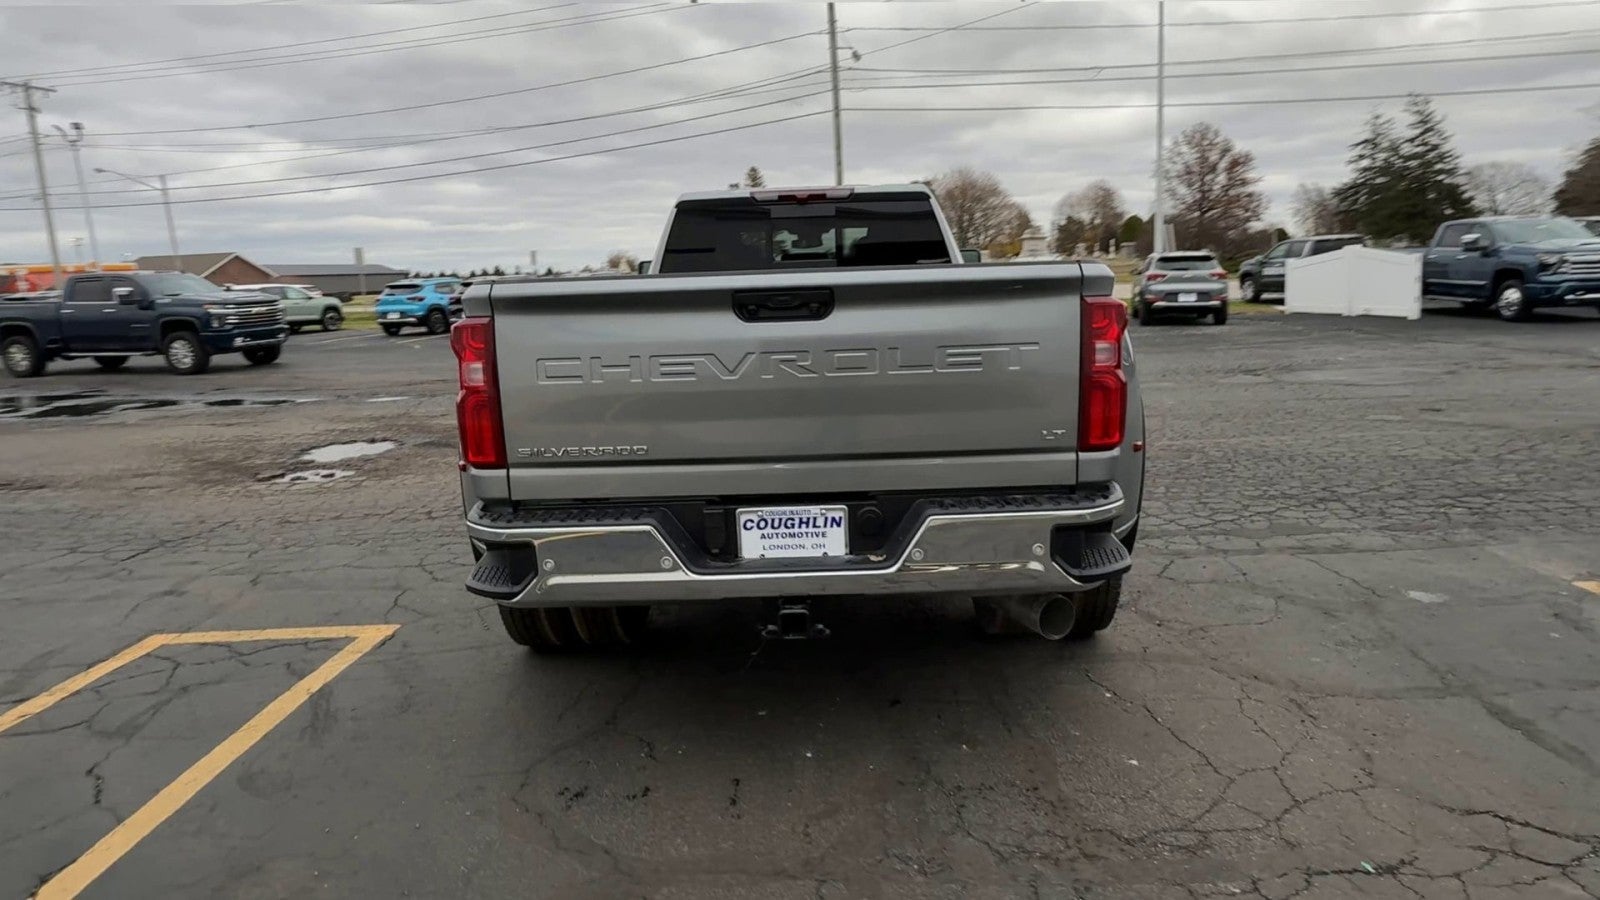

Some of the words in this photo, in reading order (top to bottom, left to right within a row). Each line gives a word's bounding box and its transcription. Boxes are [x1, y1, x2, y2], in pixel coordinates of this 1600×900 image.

[536, 342, 1040, 385] CHEVROLET
[1041, 429, 1066, 440] LT
[518, 445, 648, 457] SILVERADO
[743, 516, 843, 531] COUGHLIN
[760, 531, 828, 540] AUTOMOTIVE
